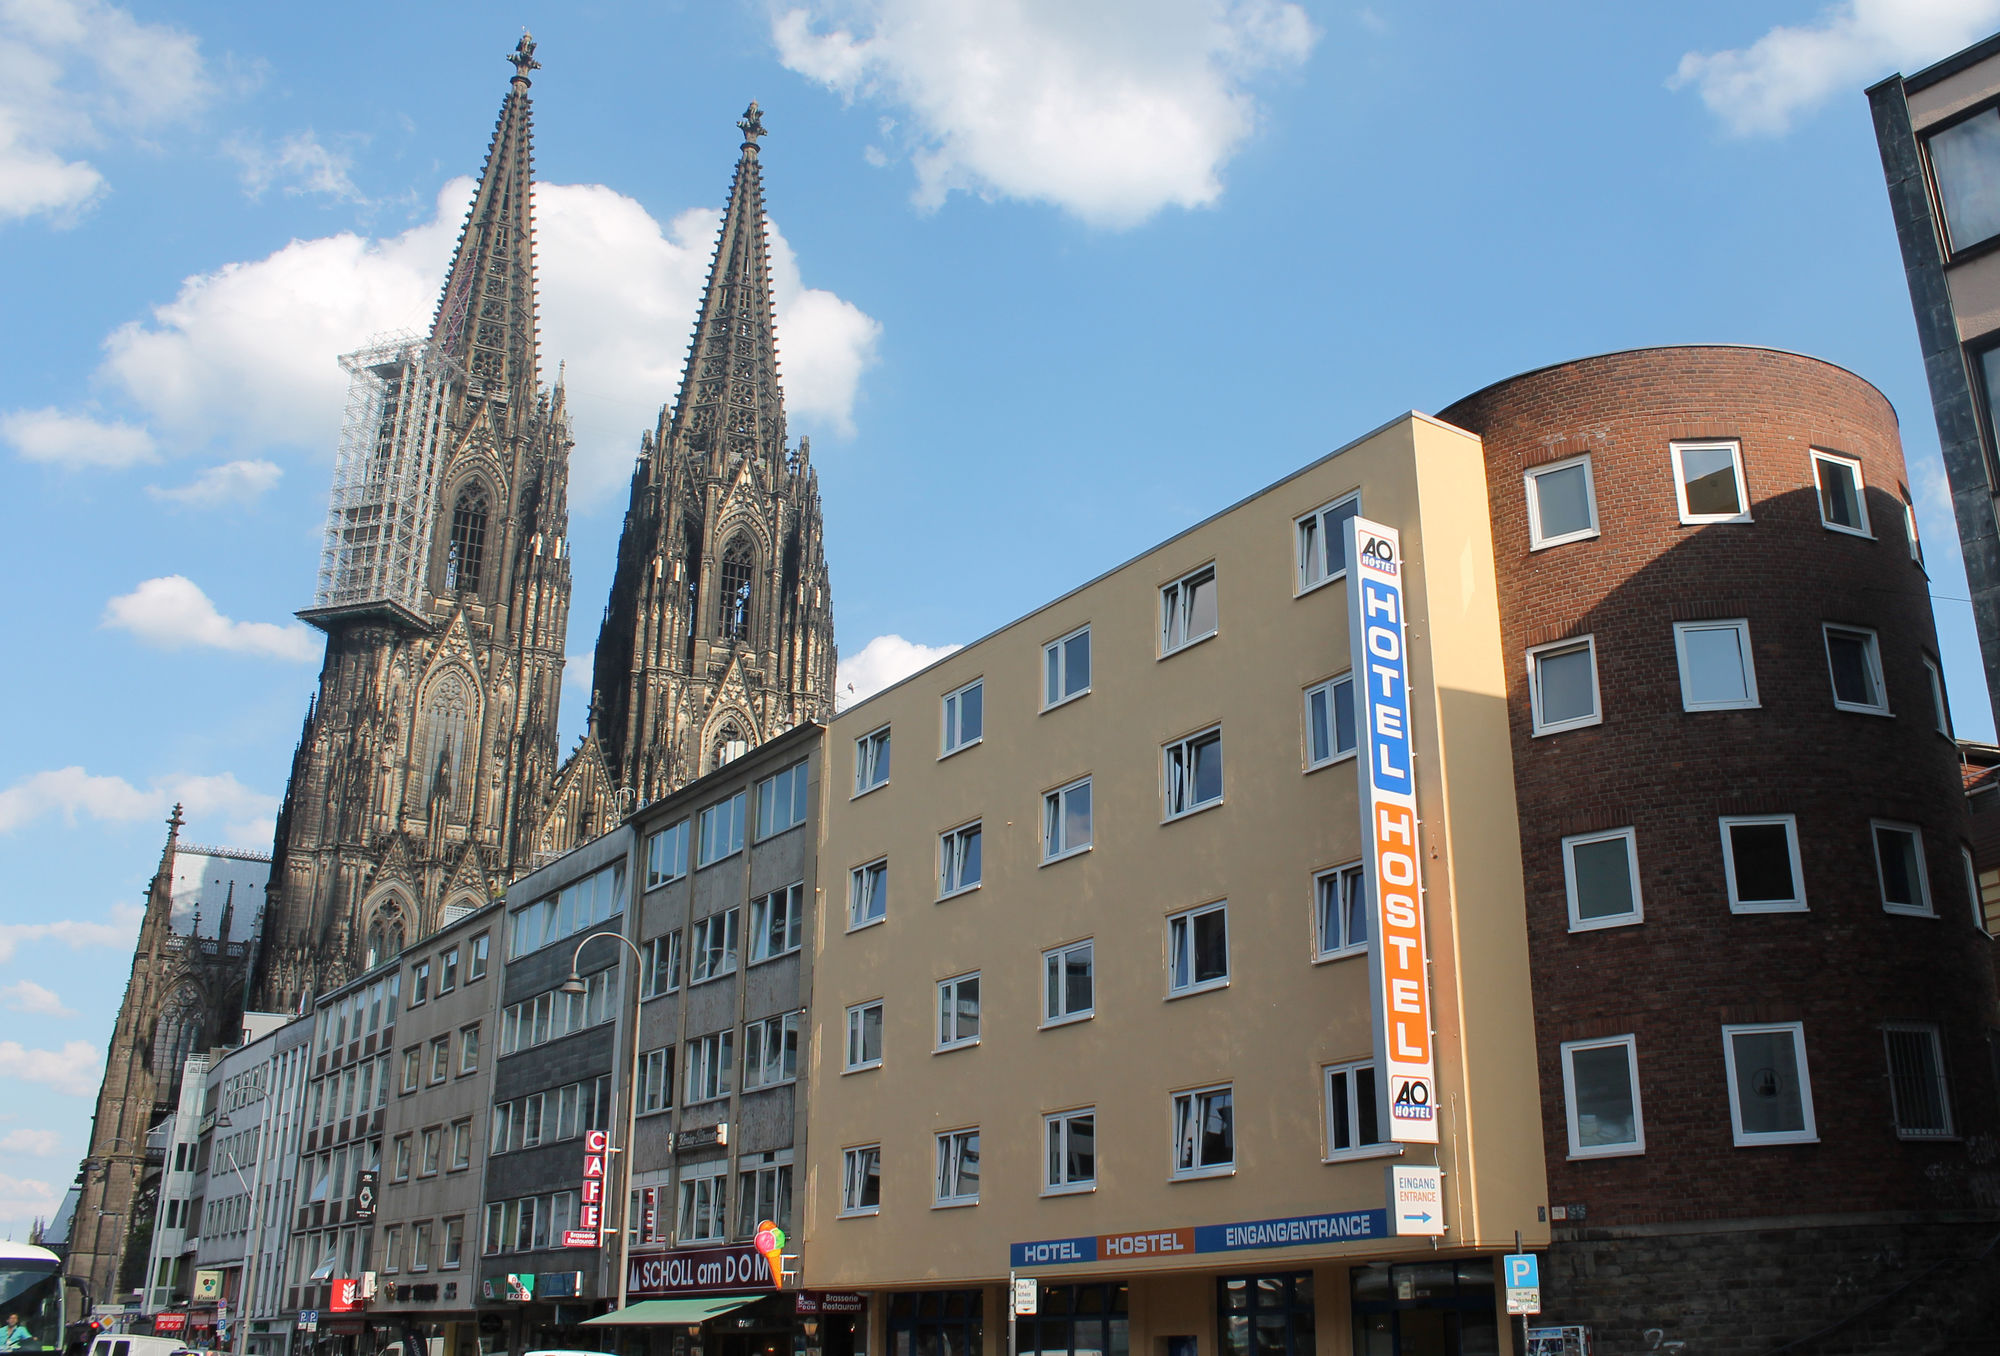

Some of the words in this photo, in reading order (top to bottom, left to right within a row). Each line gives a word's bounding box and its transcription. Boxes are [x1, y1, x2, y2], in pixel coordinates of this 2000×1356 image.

[1363, 537, 1393, 561] AO
[1362, 555, 1395, 574] HOSTEL
[1366, 586, 1405, 779] HOTEL
[1379, 809, 1423, 1057] HOSTEL
[1396, 1081, 1428, 1105] AO
[1395, 1105, 1431, 1118] HOSTEL
[588, 1132, 605, 1226] CAFE
[1399, 1177, 1435, 1189] EINGANG
[1399, 1191, 1437, 1202] ENTRANCE
[1225, 1214, 1371, 1246] EINGANG/ENTRANCE
[1024, 1241, 1081, 1262] HOTEL
[1106, 1233, 1184, 1256] HOSTEL
[642, 1259, 694, 1288] SCHOLL
[697, 1262, 721, 1285] am
[725, 1254, 769, 1283] DOM
[1512, 1260, 1530, 1286] P
[822, 1302, 862, 1311] Restaurant
[825, 1294, 859, 1302] Brasserie
